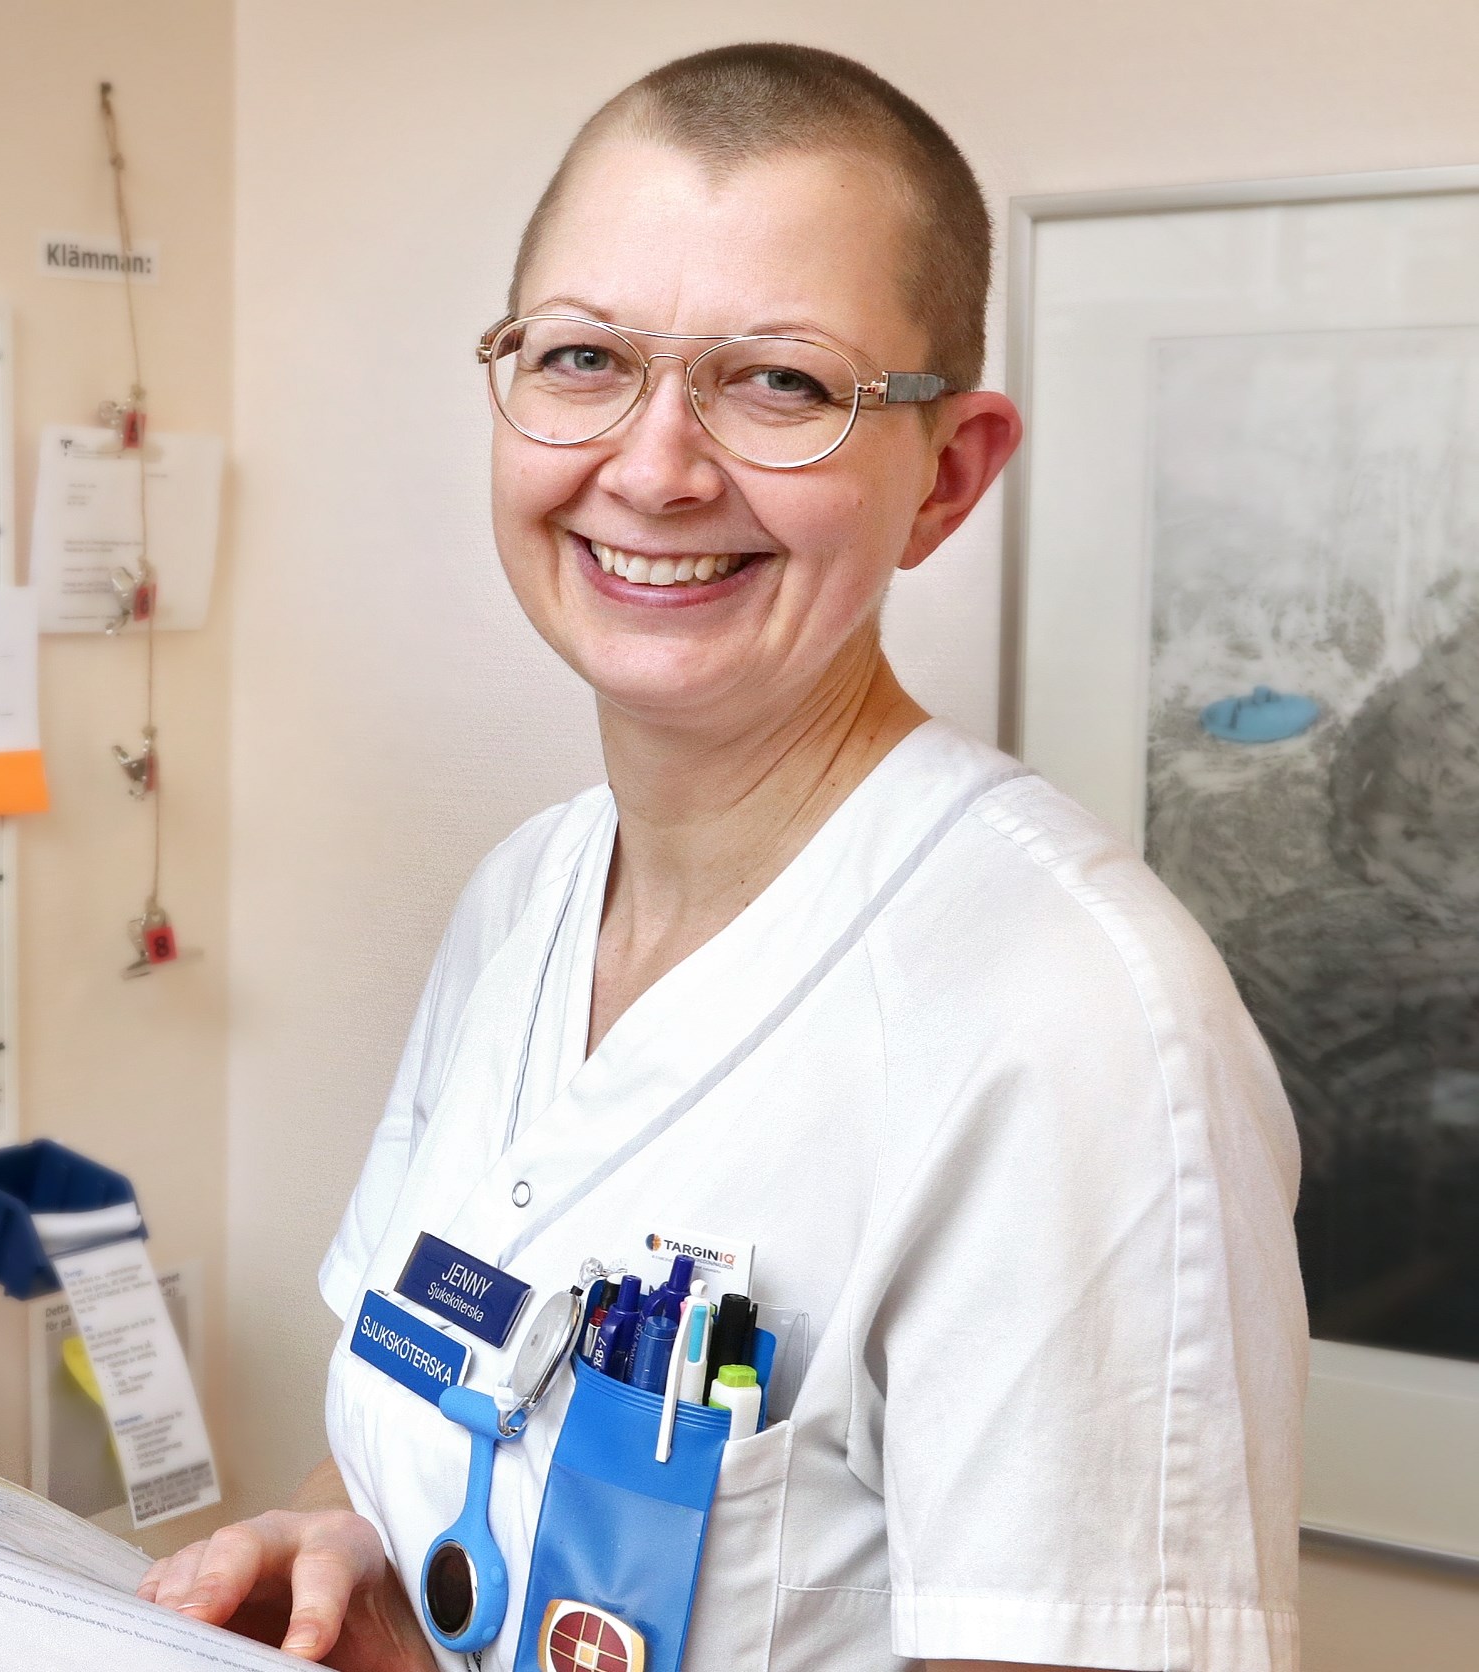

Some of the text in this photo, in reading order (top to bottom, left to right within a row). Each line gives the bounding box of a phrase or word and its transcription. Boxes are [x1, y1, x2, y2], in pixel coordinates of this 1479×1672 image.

[46, 243, 153, 274] Klämman:
[663, 1239, 735, 1266] TARGINIQ
[441, 1260, 493, 1298] JENNY
[427, 1281, 485, 1325] Sjuksköterska
[360, 1314, 453, 1389] SJUKSKÖTERSKA
[593, 1336, 607, 1366] RB-7
